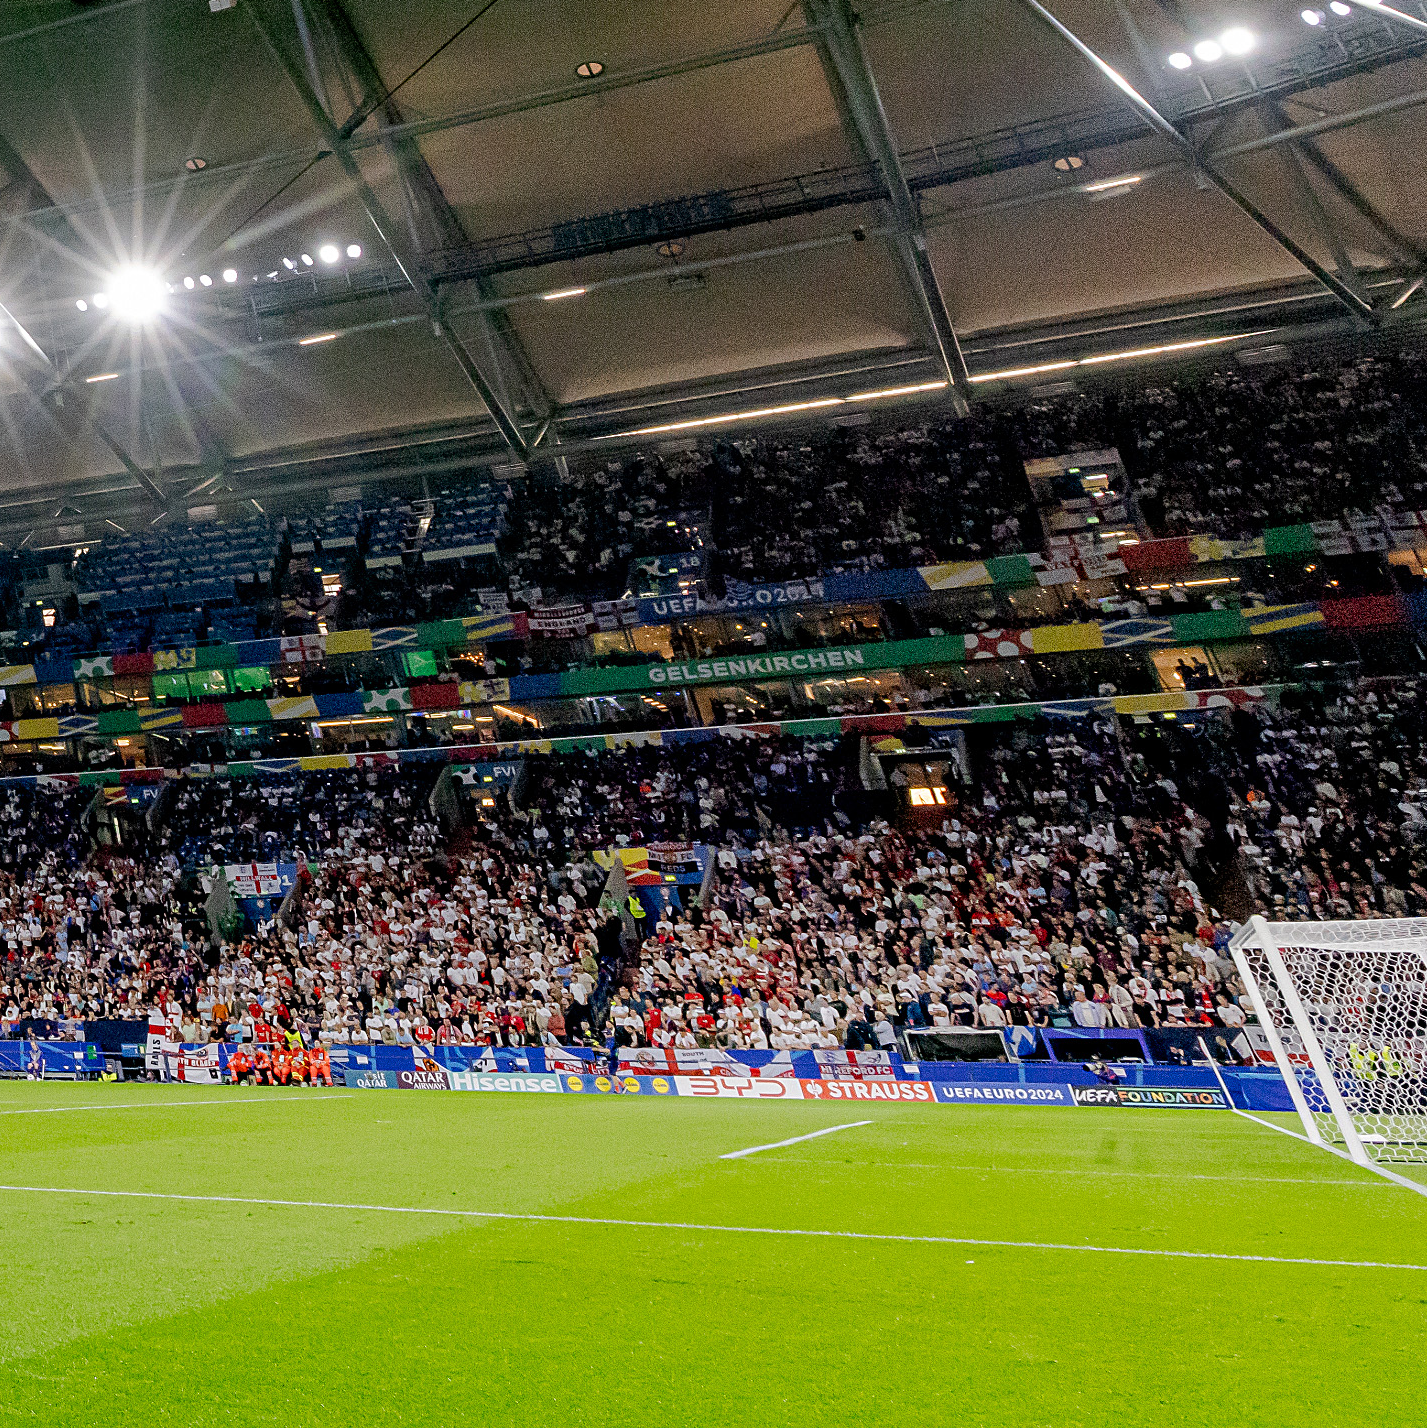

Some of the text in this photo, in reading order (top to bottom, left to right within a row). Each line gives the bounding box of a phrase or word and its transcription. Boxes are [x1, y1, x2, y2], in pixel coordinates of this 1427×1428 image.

[537, 617, 587, 628] ENGLAND
[648, 650, 865, 684] GELSENKIRCHEN
[660, 863, 686, 872] REDS
[877, 1065, 891, 1075] FC
[401, 1071, 446, 1083] QATAR
[454, 1073, 557, 1092] Hisense
[356, 1078, 388, 1089] QATAR
[413, 1082, 448, 1091] AIRWAYS
[690, 1077, 787, 1097] BYD
[828, 1081, 930, 1101] STRAUSS
[1075, 1088, 1226, 1105] UEFA FOUNDATION
